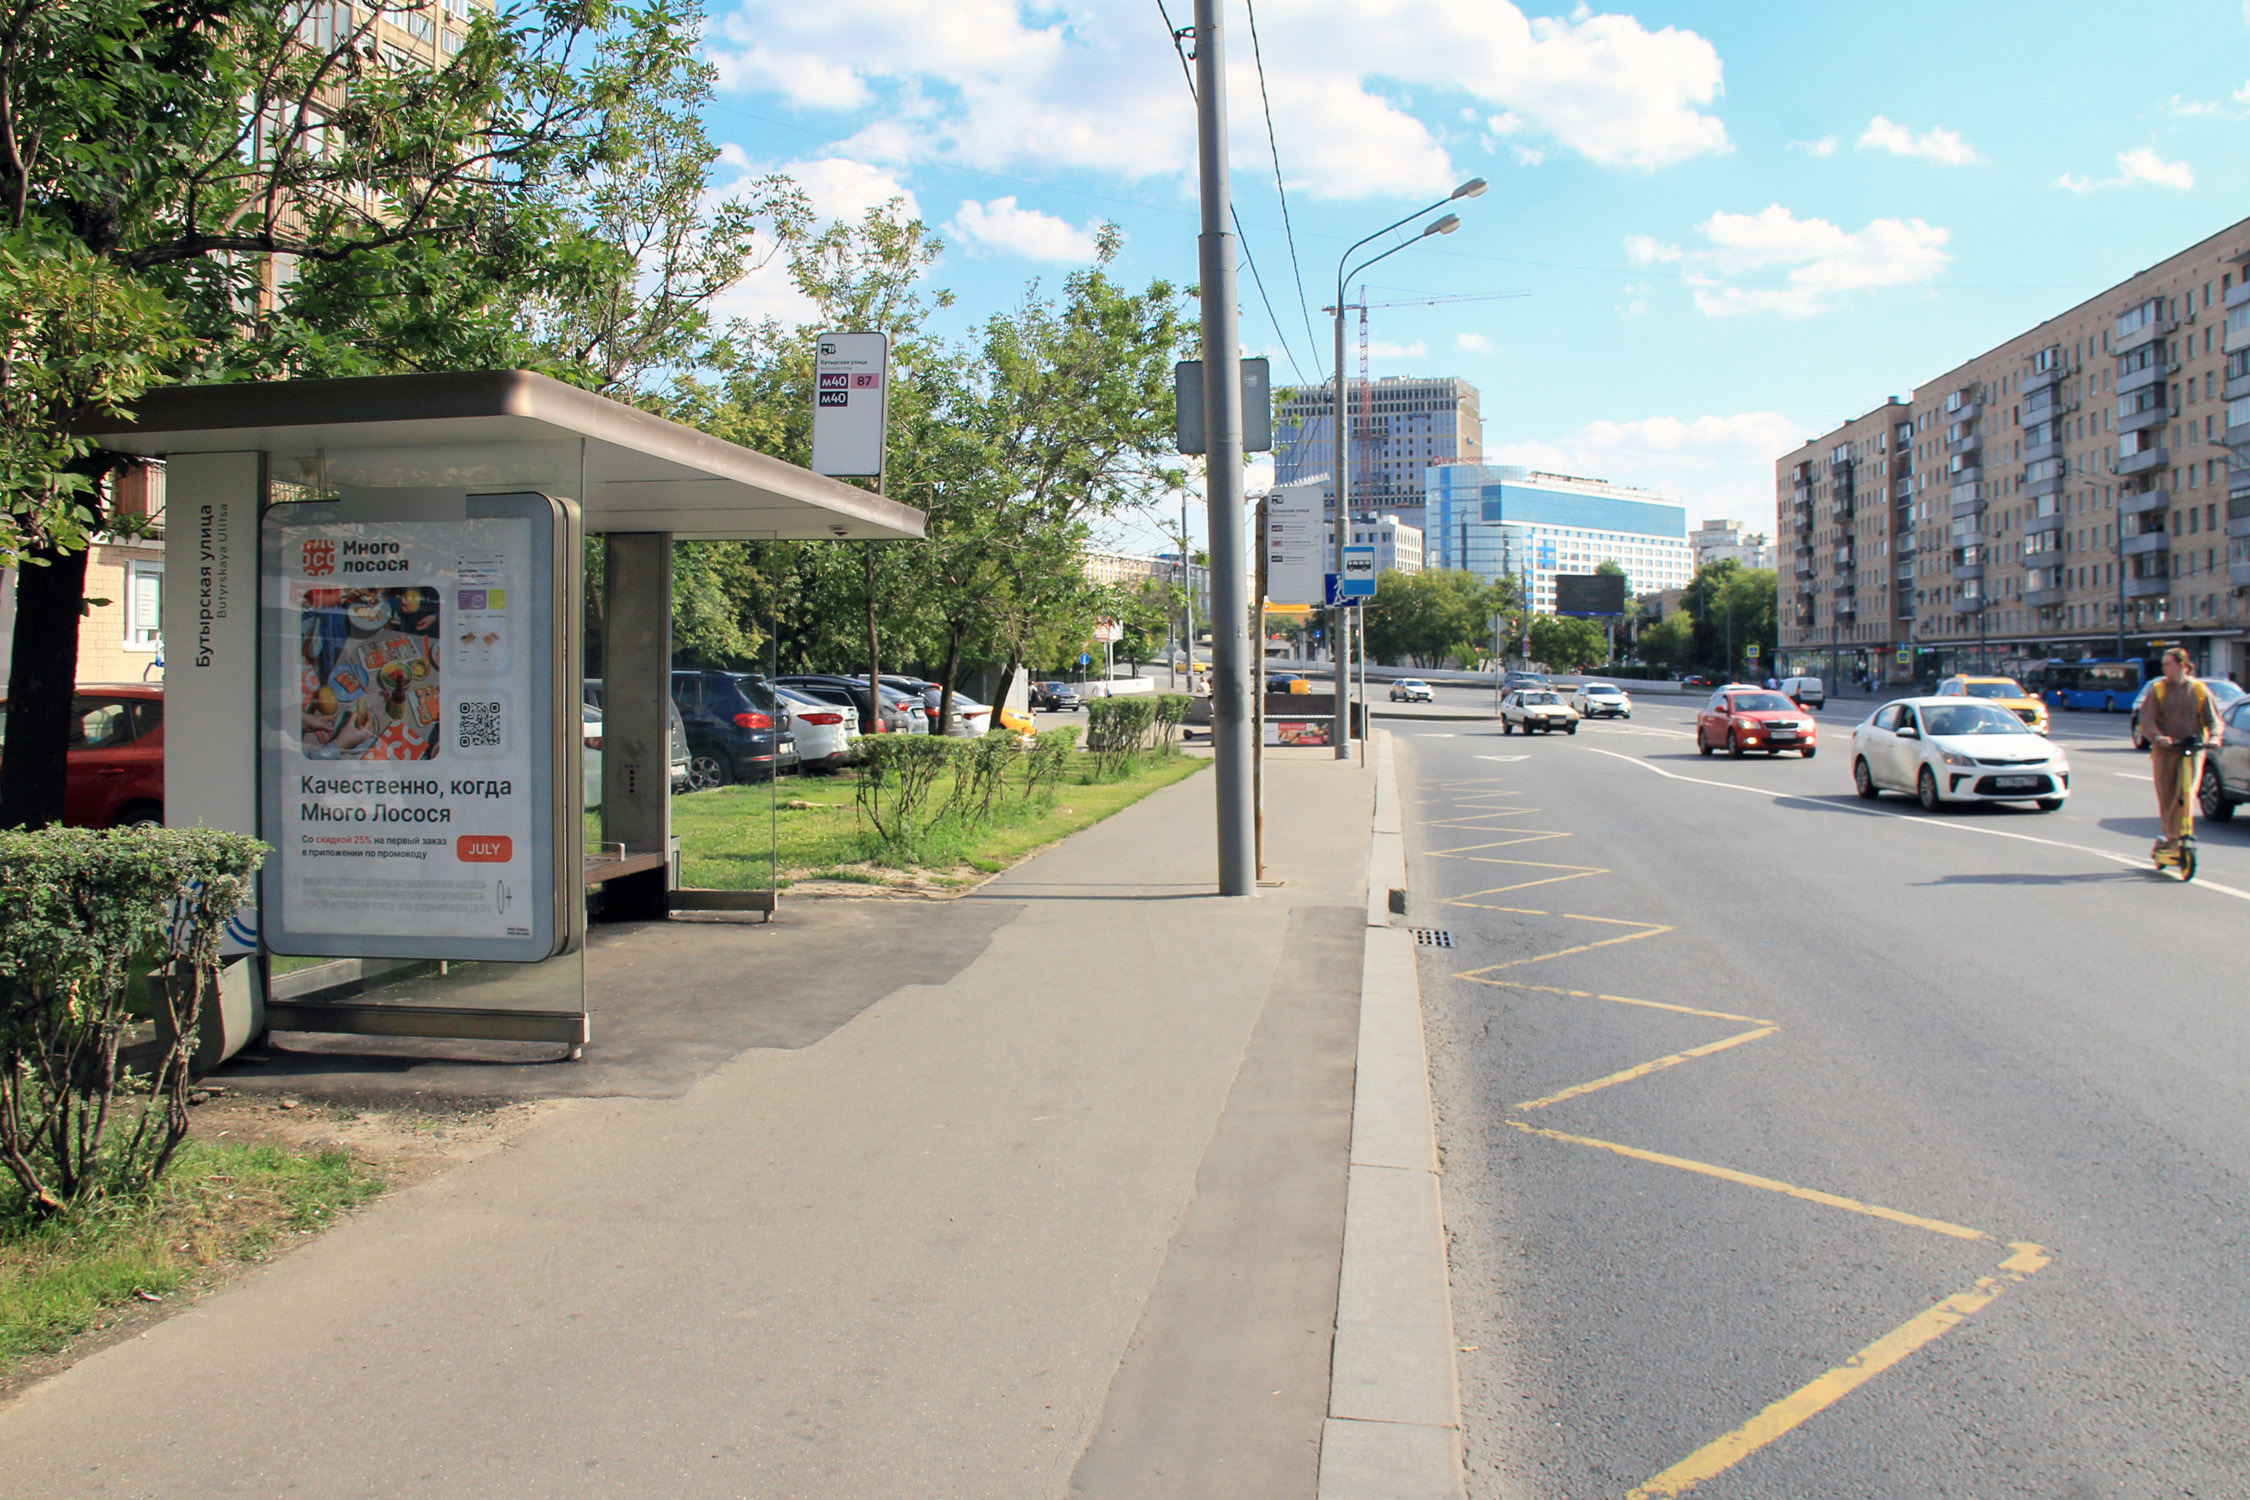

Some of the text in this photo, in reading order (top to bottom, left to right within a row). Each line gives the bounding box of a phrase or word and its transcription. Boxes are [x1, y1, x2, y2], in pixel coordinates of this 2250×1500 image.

[857, 376, 872, 386] 87
[343, 540, 400, 555] Много
[217, 503, 229, 618] Butyrskaya Ulitsa
[343, 559, 409, 573] лосося
[196, 504, 215, 668] Бутырская улица
[301, 775, 512, 799] Качественно, когда
[301, 803, 451, 823] Много Лосося
[302, 835, 314, 844] Со
[315, 835, 352, 845] скидкой
[354, 835, 372, 844] 25%
[386, 837, 420, 847] первый
[422, 838, 447, 846] заказ
[309, 849, 363, 858] приложении
[377, 850, 428, 860] промокоду
[468, 843, 501, 855] JULY
